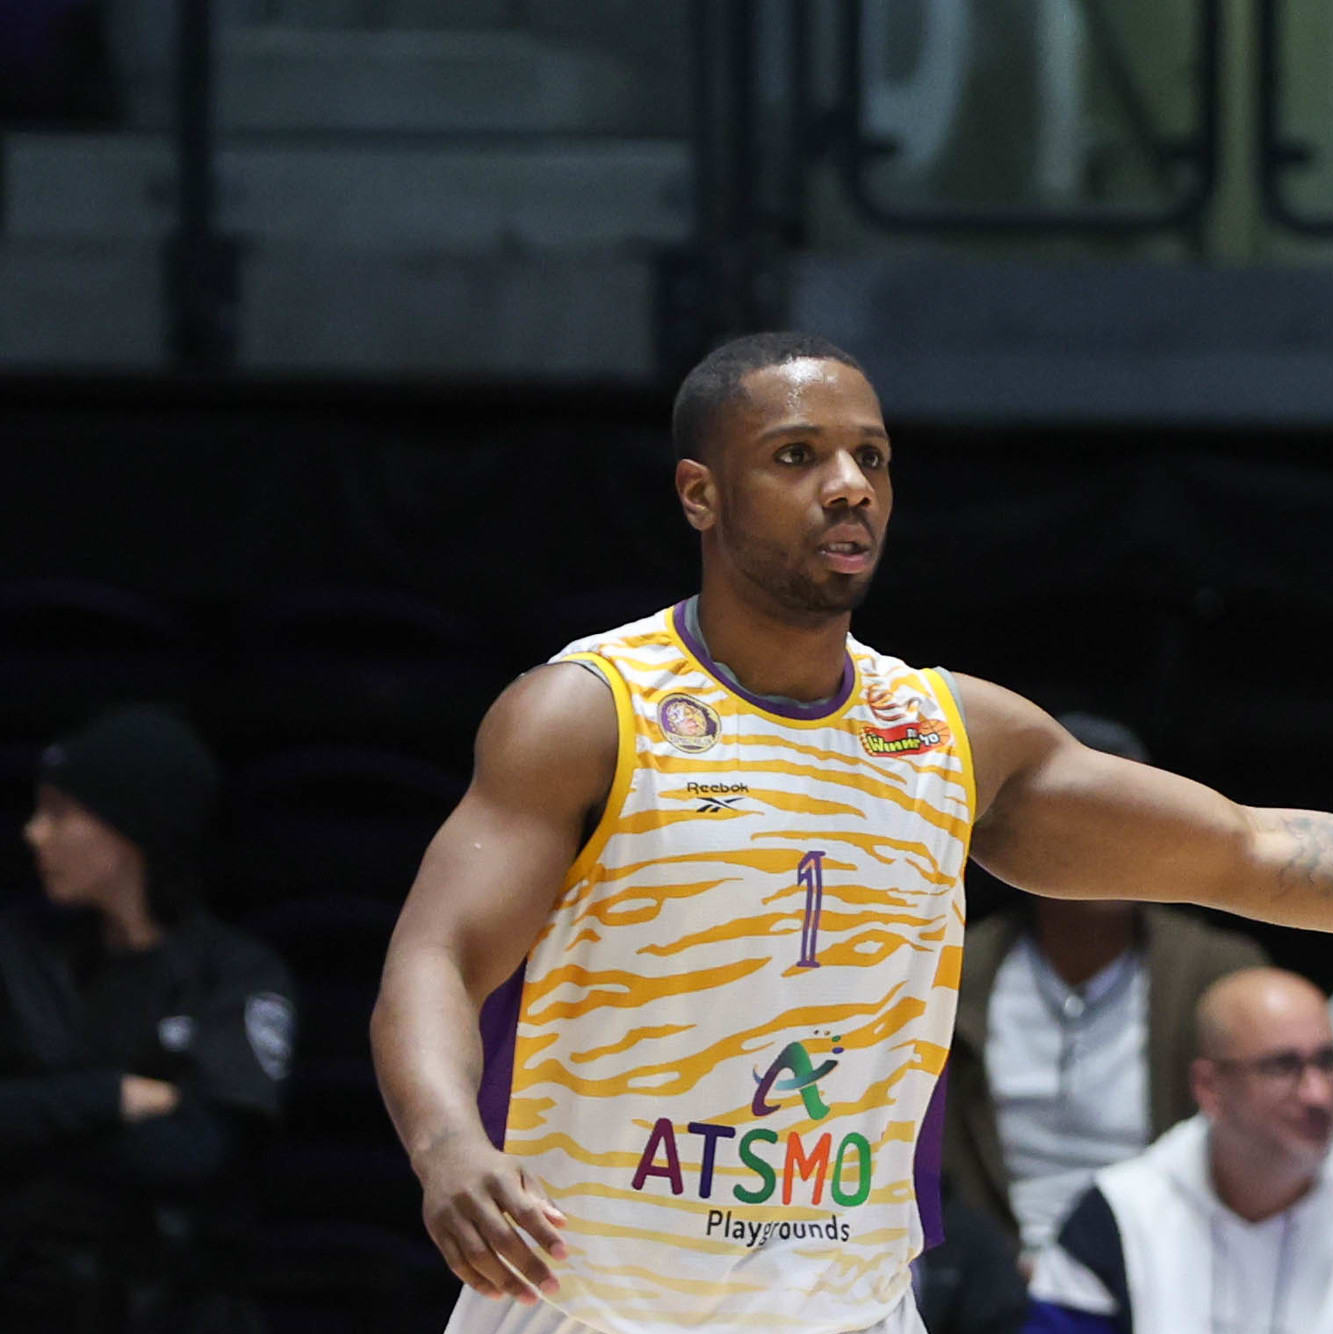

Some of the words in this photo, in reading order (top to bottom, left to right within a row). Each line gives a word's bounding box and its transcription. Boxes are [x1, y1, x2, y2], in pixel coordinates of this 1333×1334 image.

[686, 782, 750, 795] Reebok
[796, 850, 826, 968] 1
[631, 1117, 872, 1208] ATSMO
[706, 1209, 851, 1248] Playgrounds
